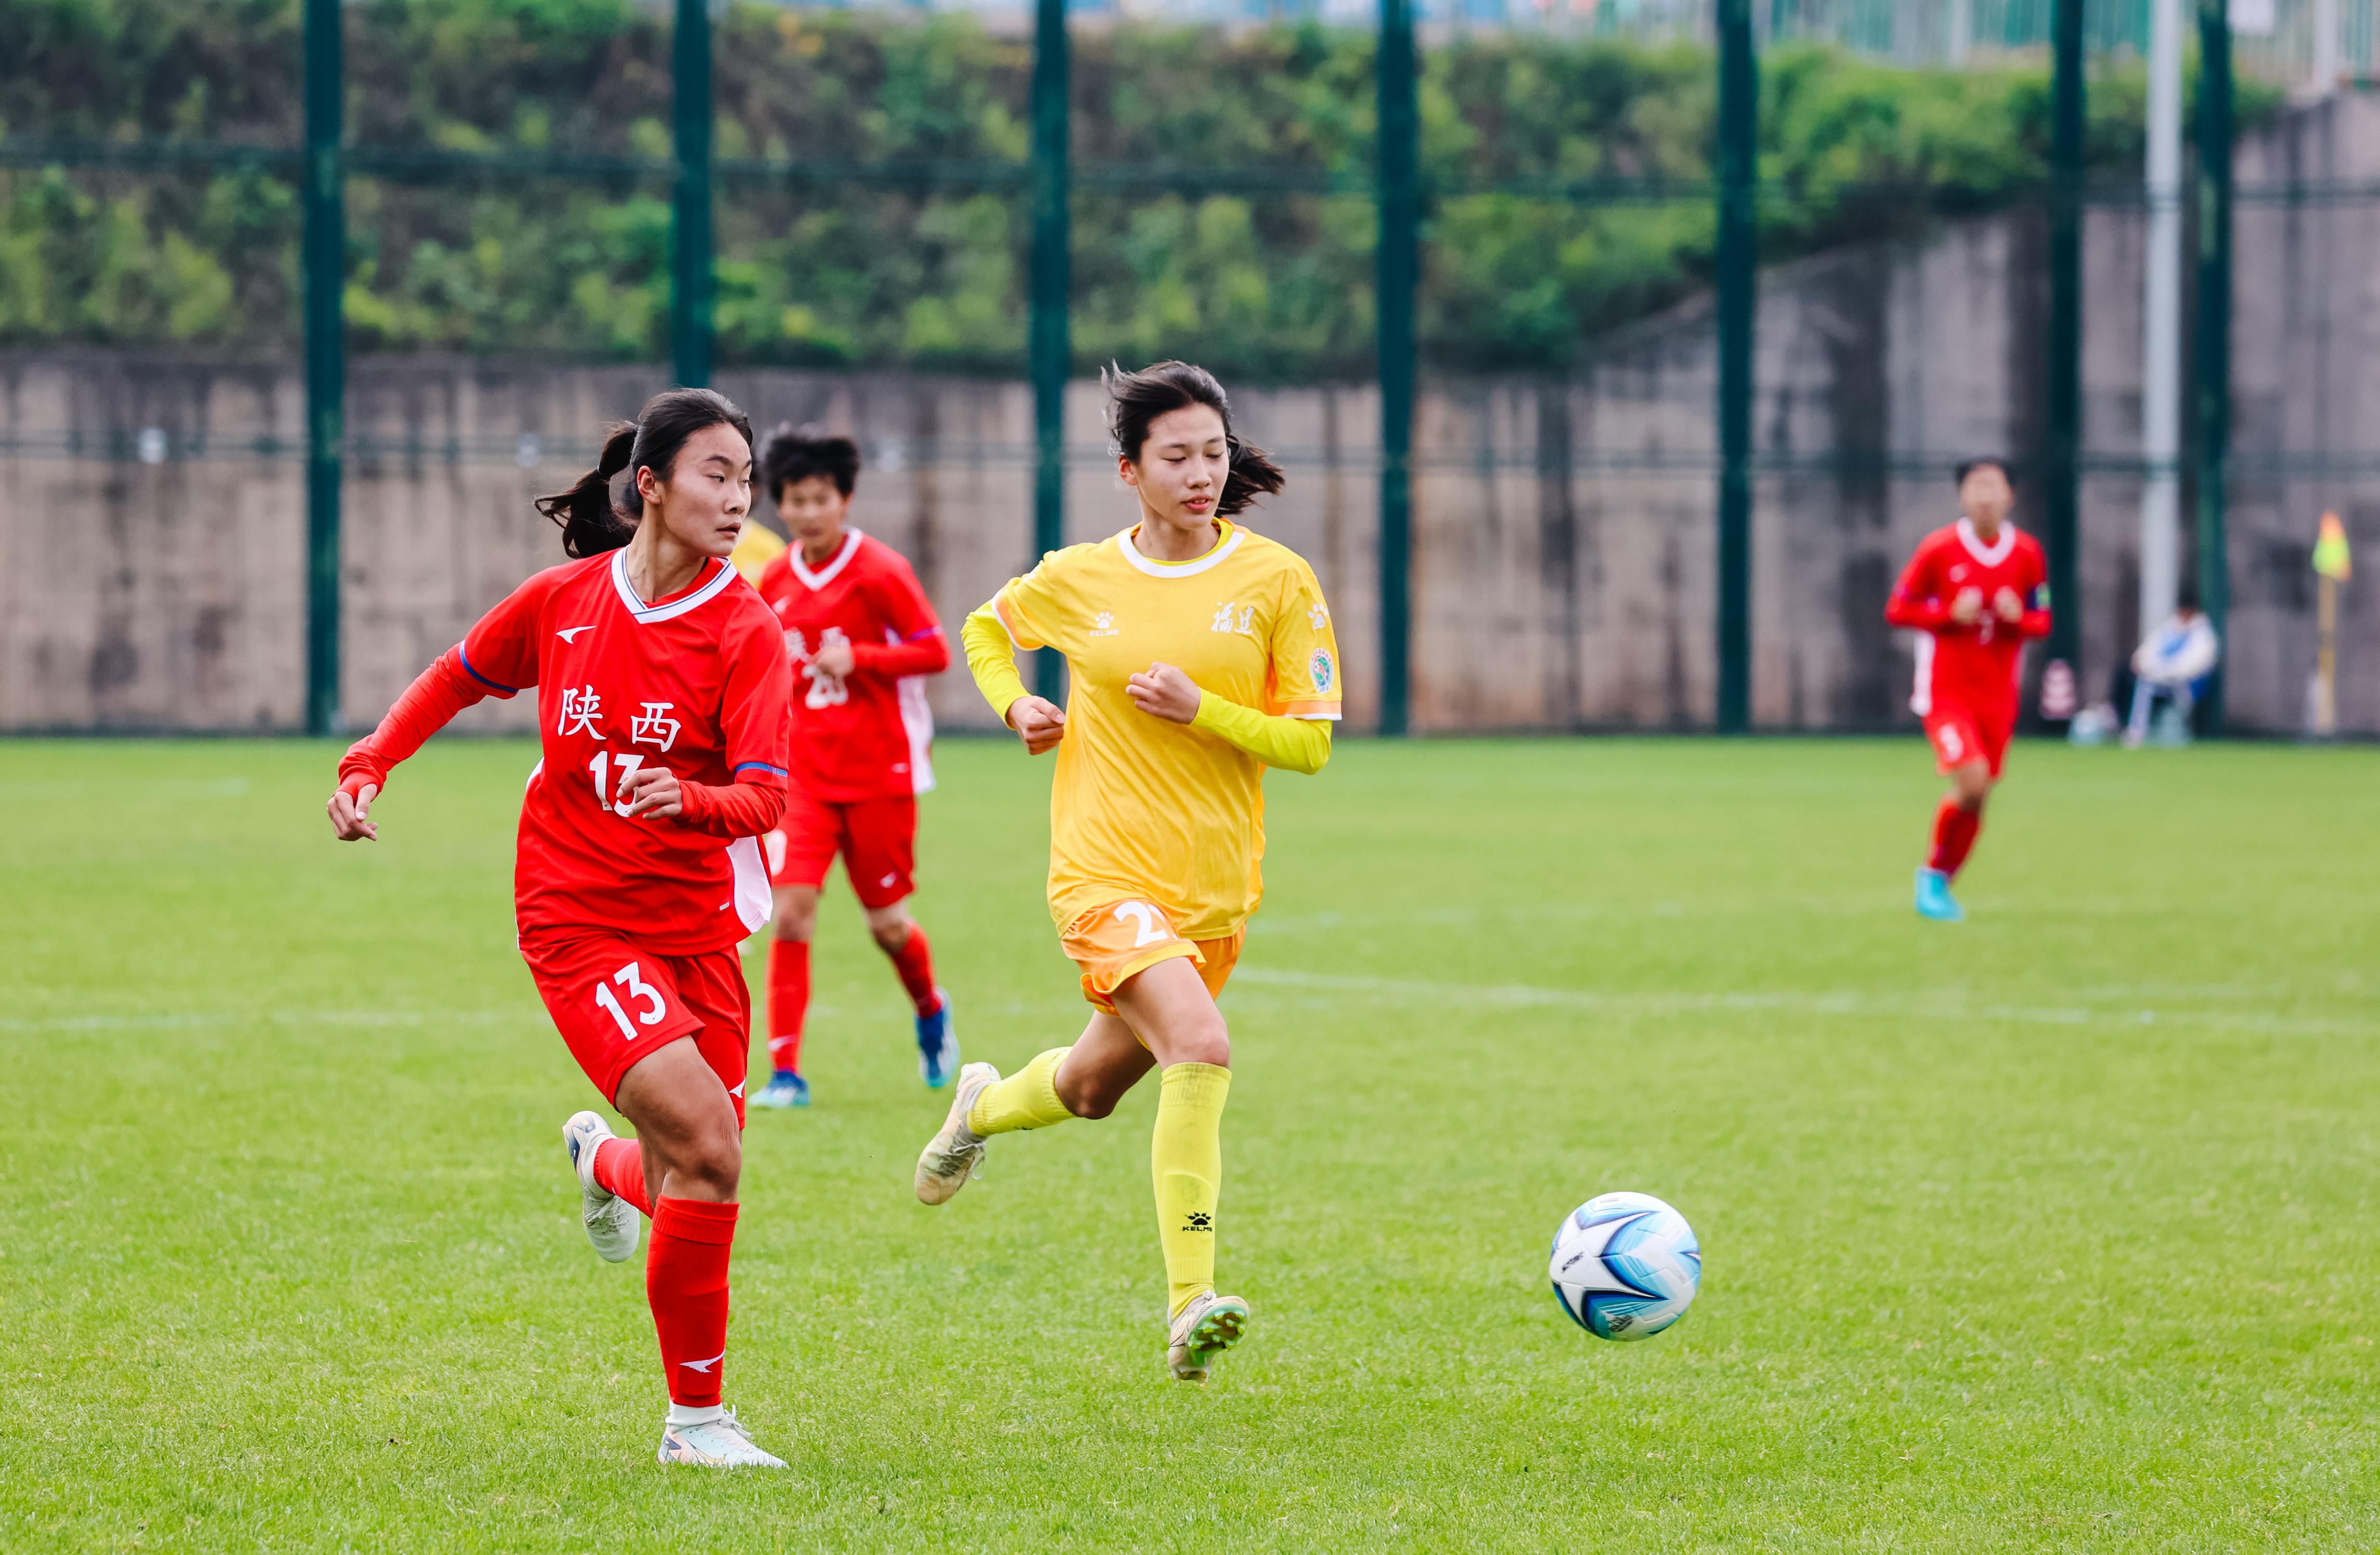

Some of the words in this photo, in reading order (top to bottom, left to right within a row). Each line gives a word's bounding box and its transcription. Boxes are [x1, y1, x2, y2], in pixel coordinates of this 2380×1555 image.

[557, 685, 681, 752] 陕西
[1113, 901, 1179, 948] 2
[595, 961, 666, 1041] 13
